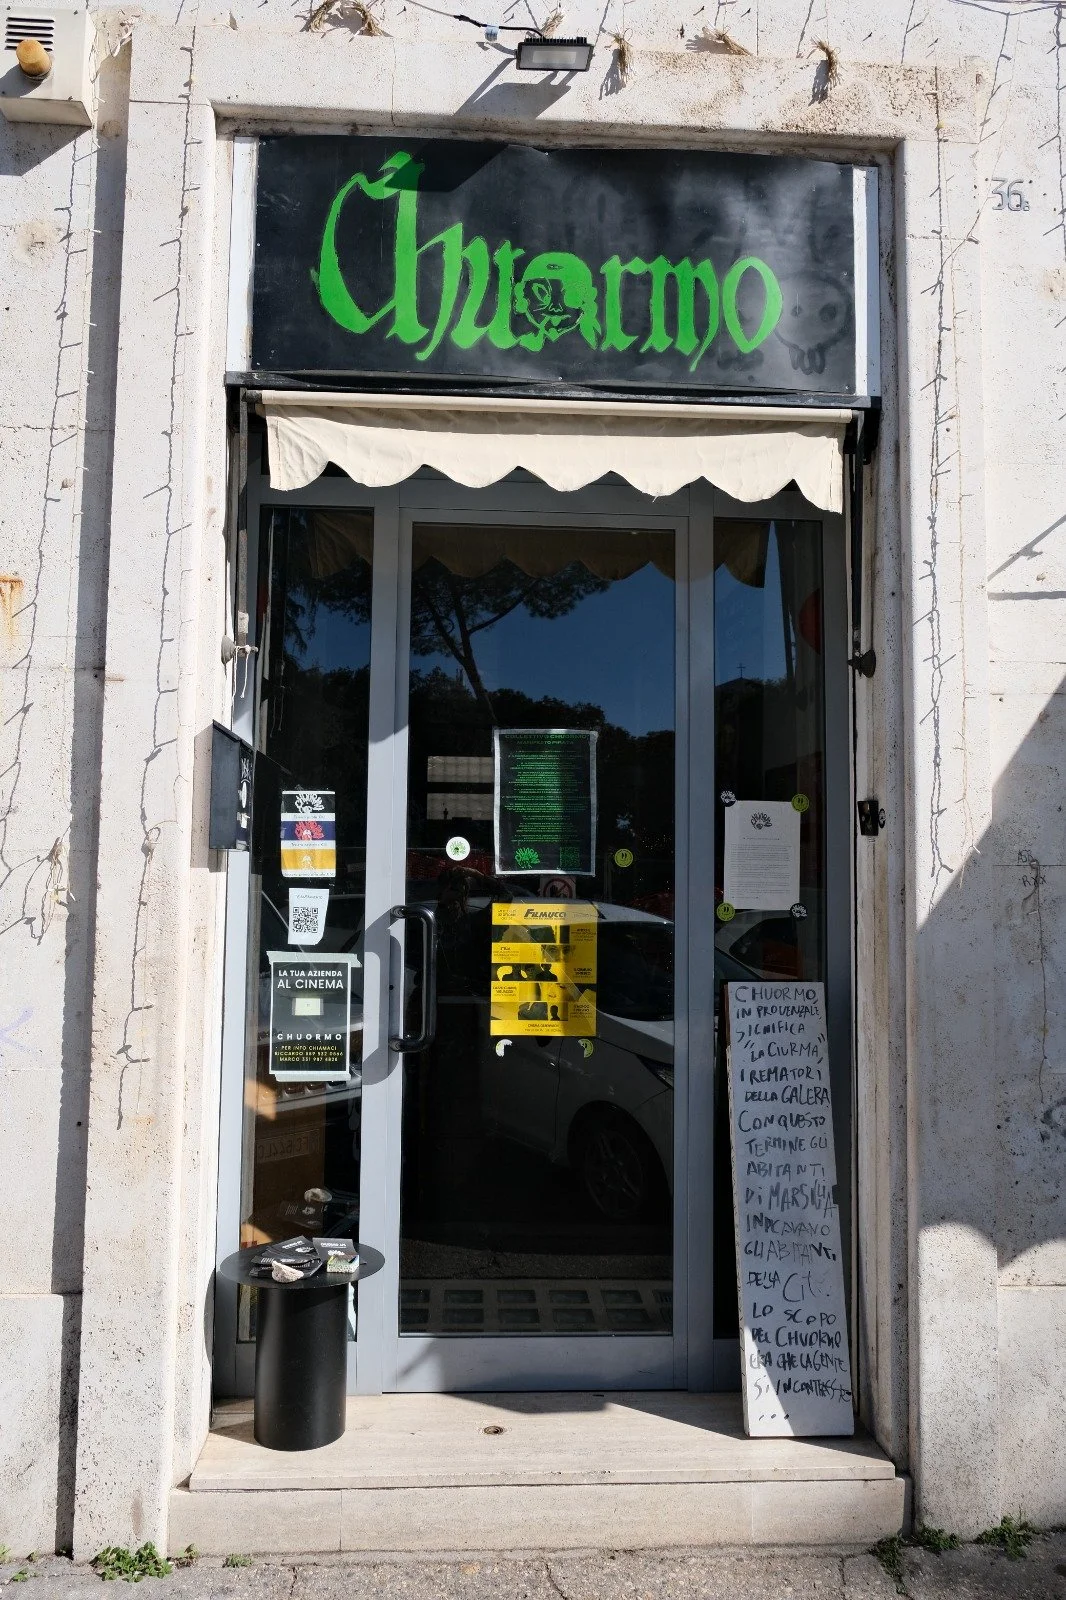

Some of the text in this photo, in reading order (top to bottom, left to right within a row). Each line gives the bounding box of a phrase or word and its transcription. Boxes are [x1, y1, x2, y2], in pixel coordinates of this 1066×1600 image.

[277, 979, 344, 989] AL CINEMA
[736, 1007, 752, 1019] IN
[744, 1091, 778, 1102] DELLA
[745, 1136, 806, 1157] TERMINE
[747, 1161, 825, 1181] ABITANTI
[752, 1302, 837, 1328] LO SCOPO
